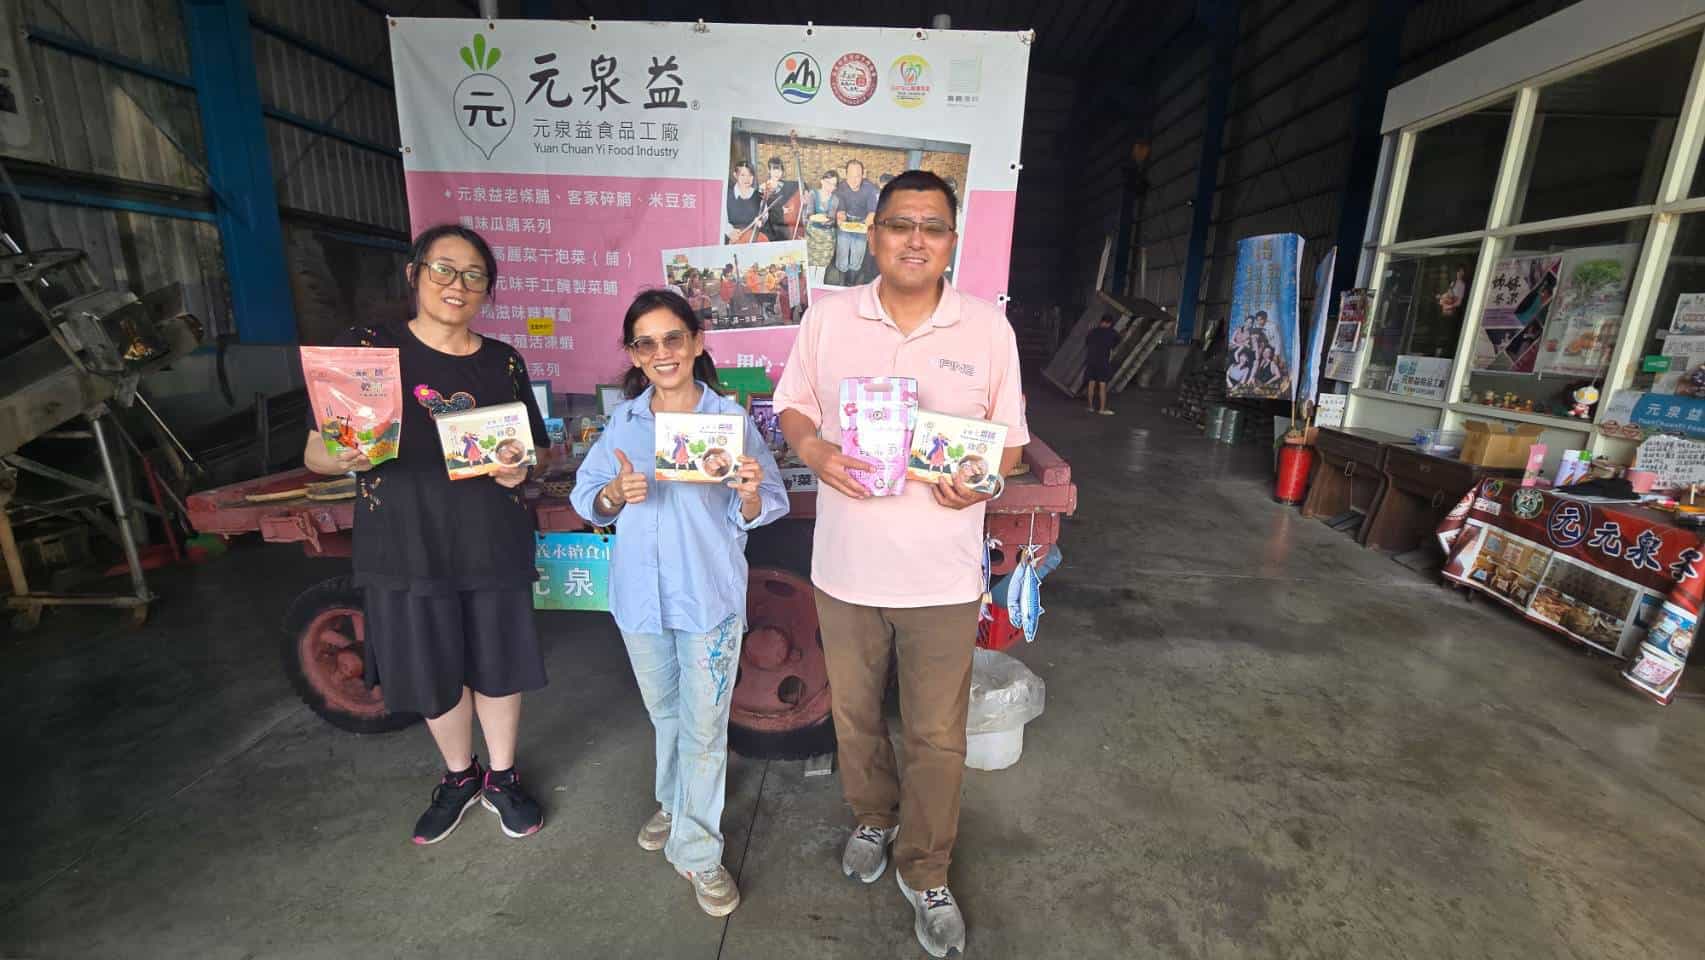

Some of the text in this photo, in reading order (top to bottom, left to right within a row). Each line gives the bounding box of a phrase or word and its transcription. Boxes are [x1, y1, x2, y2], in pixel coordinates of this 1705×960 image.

[525, 53, 689, 110] 元泉益
[463, 91, 507, 127] 元
[533, 118, 679, 141] 元泉益食品工廠
[534, 143, 679, 159] Yuan Chuan Yi Food Industry
[1645, 403, 1703, 421] 元泉益
[1551, 508, 1582, 541] 元
